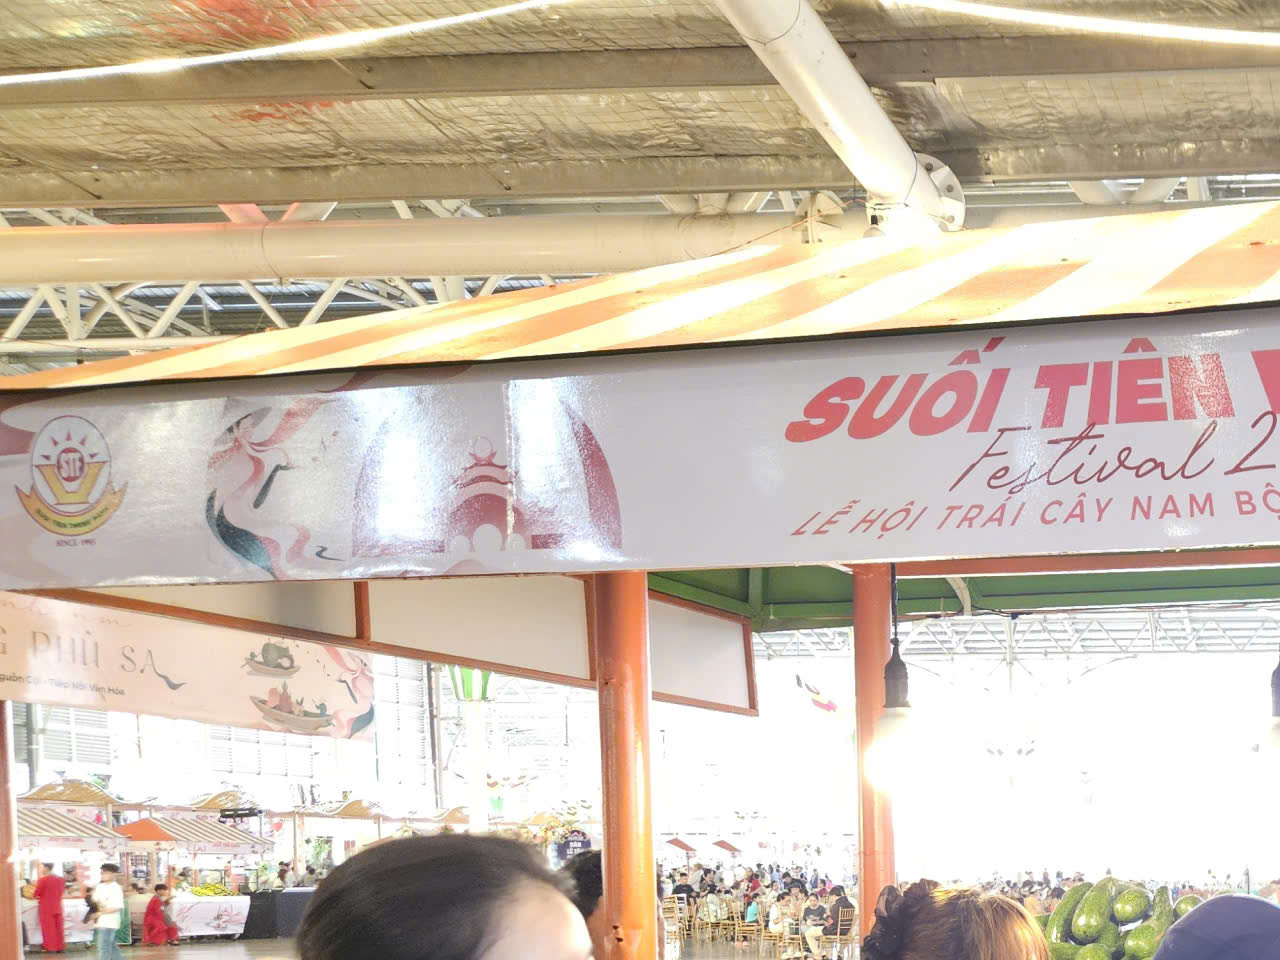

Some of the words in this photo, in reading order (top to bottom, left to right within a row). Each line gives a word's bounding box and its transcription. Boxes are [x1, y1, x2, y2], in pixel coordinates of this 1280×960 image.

[785, 336, 1007, 442] SUỐI
[1034, 337, 1236, 430] TIÊN
[949, 419, 1215, 494] Festival
[791, 499, 861, 536] LỄ
[848, 500, 929, 539] HỘI
[936, 496, 1026, 530] TRÁI
[1039, 492, 1114, 525] CÂY
[1131, 492, 1215, 520] NAM
[120, 645, 188, 690] SA
